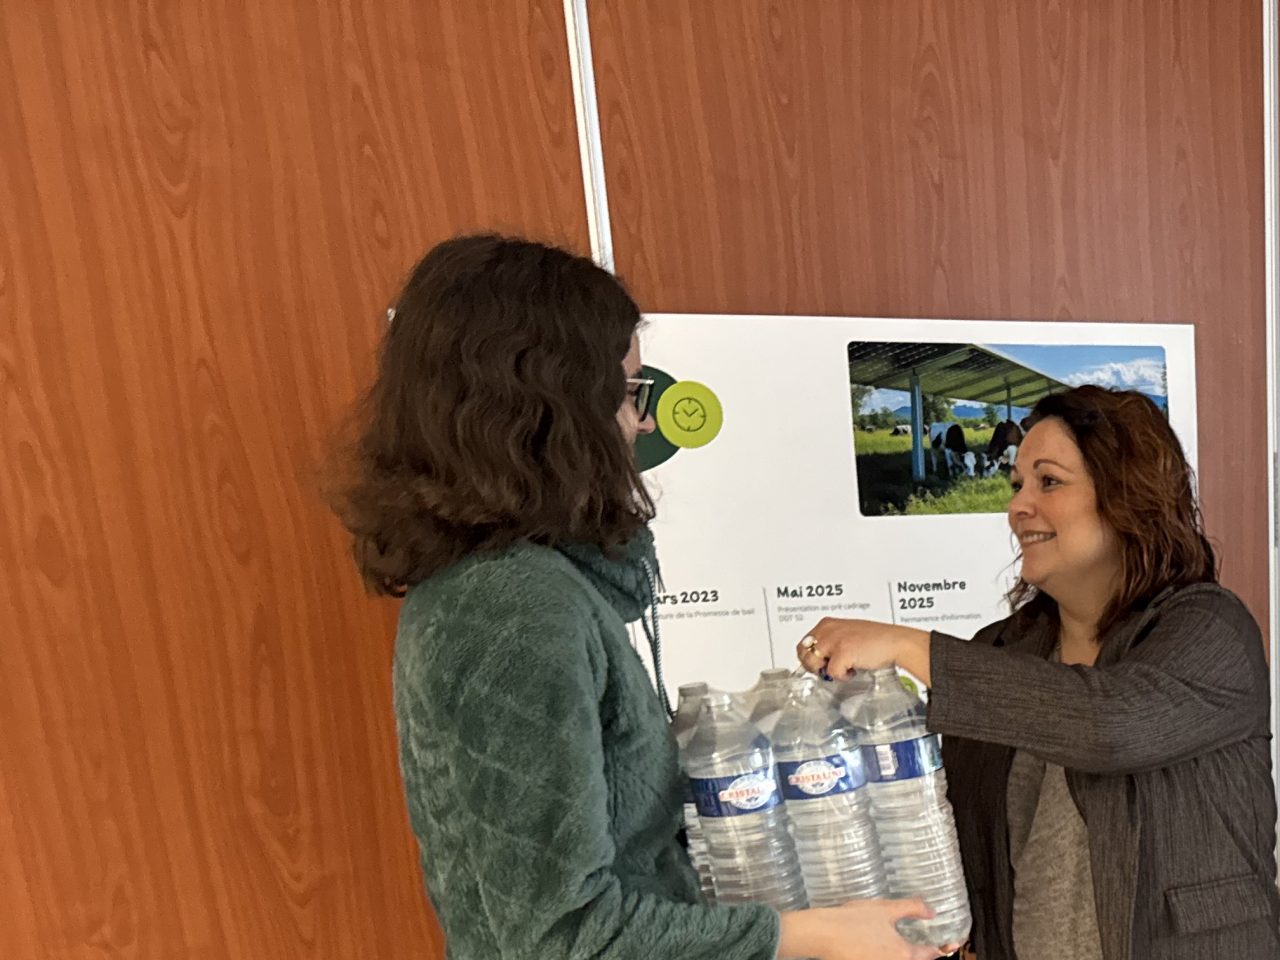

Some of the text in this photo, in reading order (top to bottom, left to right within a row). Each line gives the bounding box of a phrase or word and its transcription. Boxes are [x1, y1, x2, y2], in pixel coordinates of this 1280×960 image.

[777, 584, 843, 598] Mai 2025
[898, 580, 966, 593] Novembre
[655, 590, 719, 604] ars 2023
[899, 597, 934, 610] 2025
